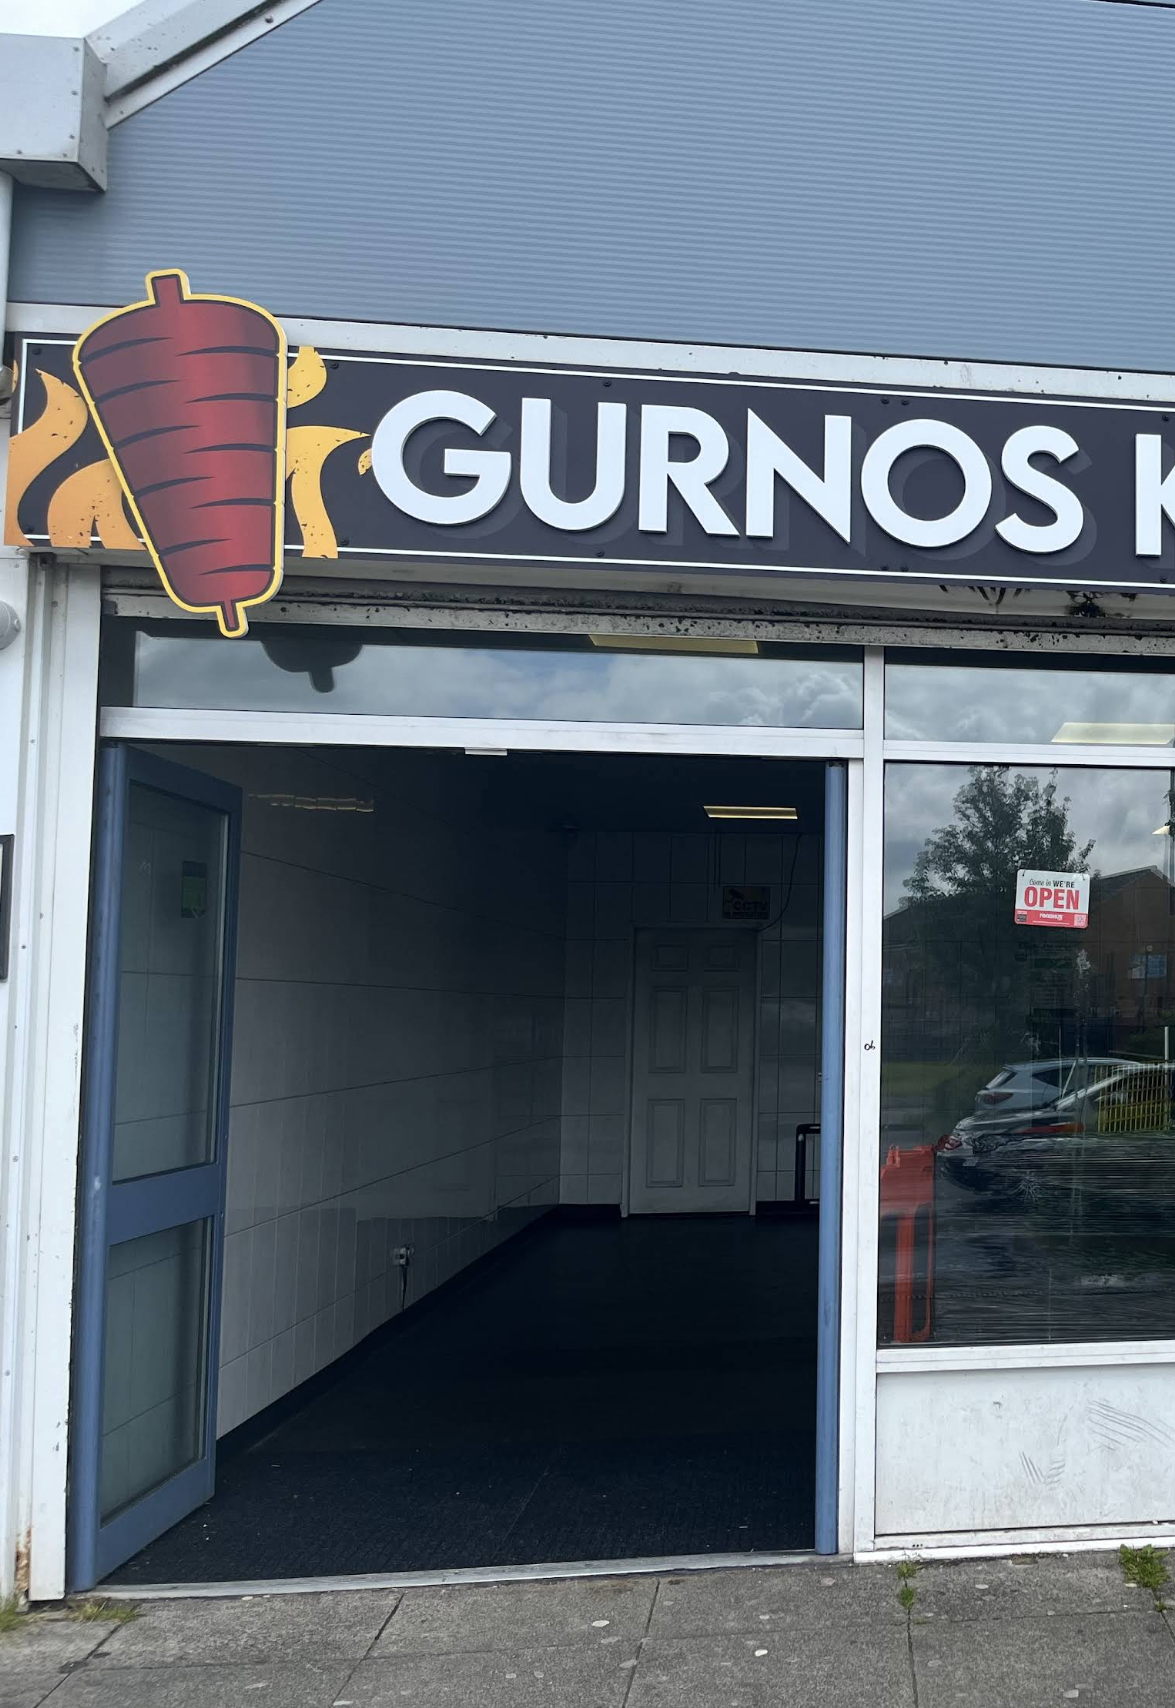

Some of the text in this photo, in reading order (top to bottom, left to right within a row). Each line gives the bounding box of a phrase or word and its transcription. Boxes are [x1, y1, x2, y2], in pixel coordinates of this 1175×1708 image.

[371, 390, 1084, 554] GURNOS
[1053, 880, 1075, 888] WE'RE
[1024, 886, 1079, 910] OPEN
